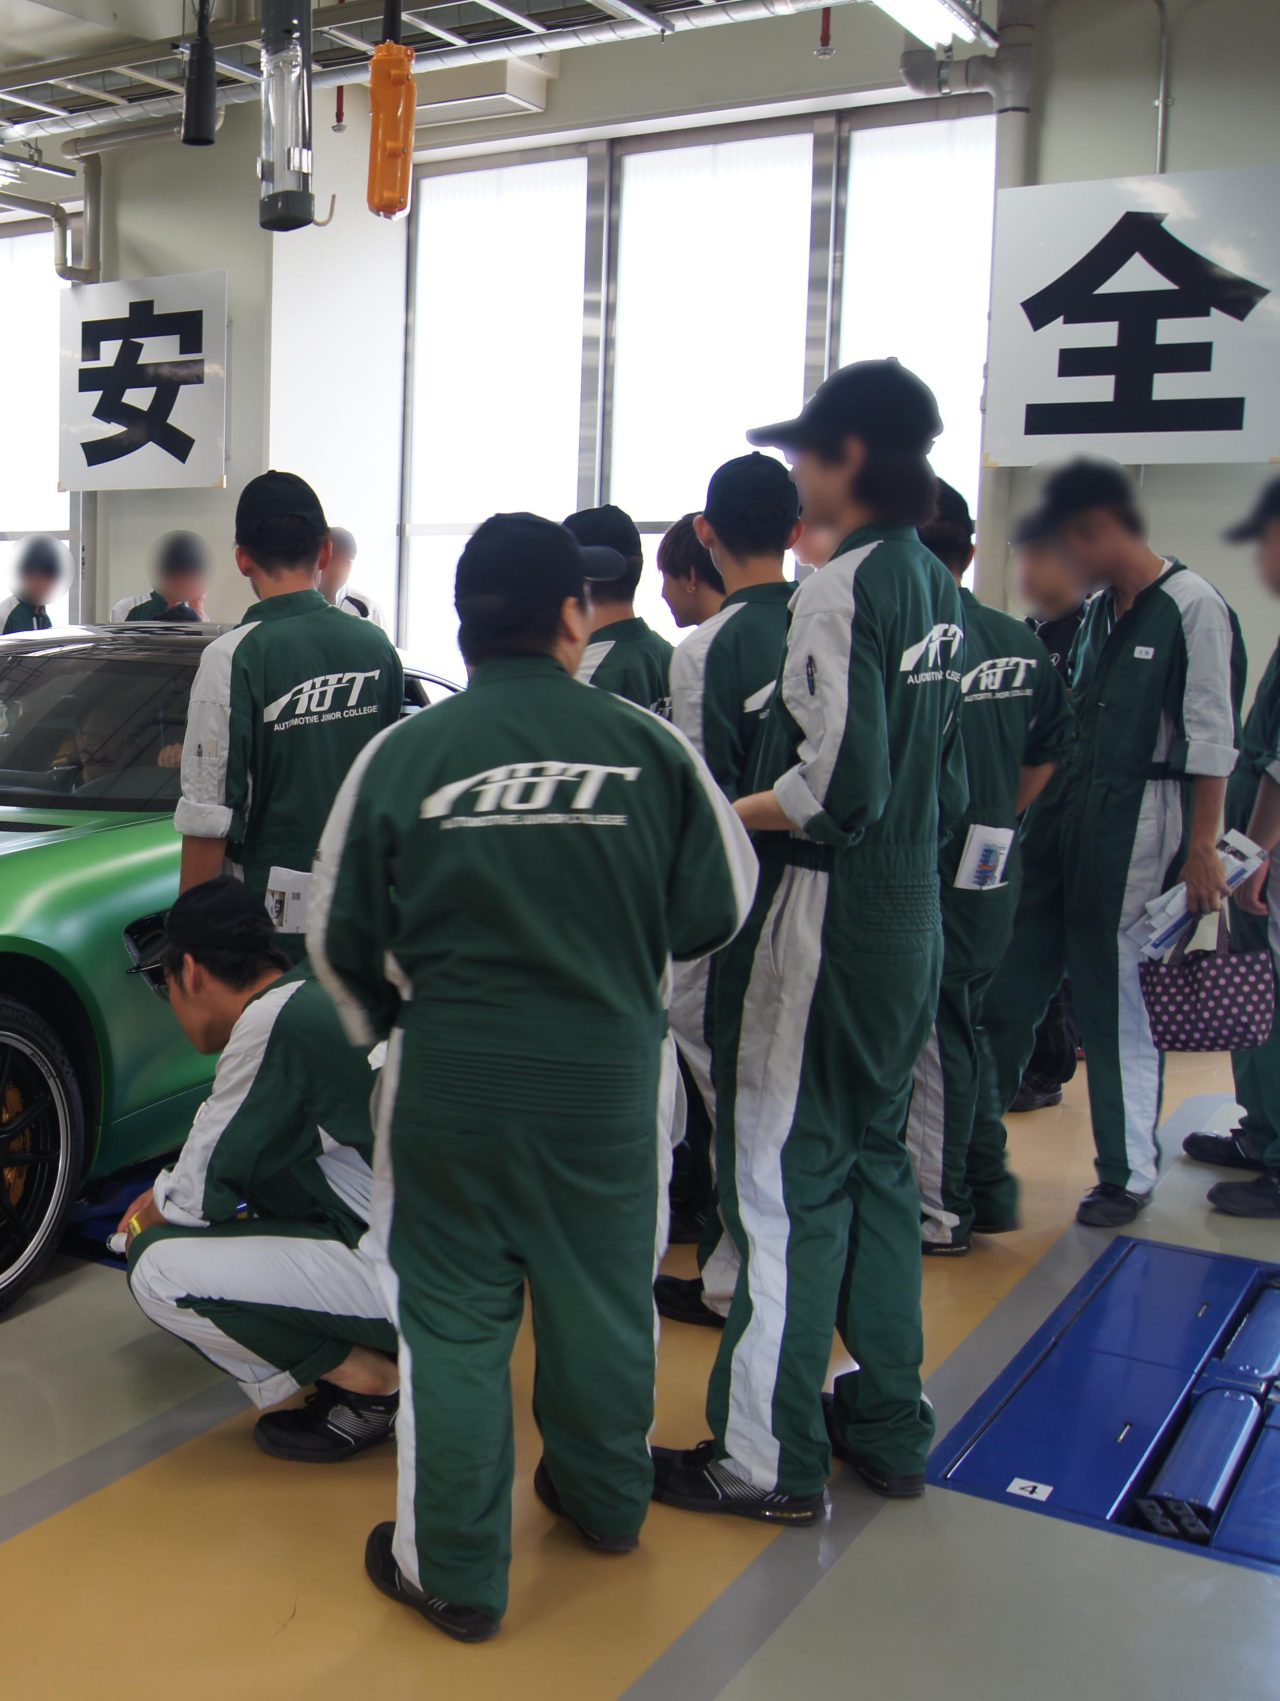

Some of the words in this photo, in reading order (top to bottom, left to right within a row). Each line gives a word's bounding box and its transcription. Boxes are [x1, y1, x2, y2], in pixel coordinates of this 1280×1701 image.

[1020, 210, 1271, 436] 全
[78, 299, 205, 467] 安
[263, 669, 381, 723] AUT
[343, 704, 378, 718] COLLEGE
[419, 760, 642, 819] AUT
[1020, 1484, 1038, 1495] 4
